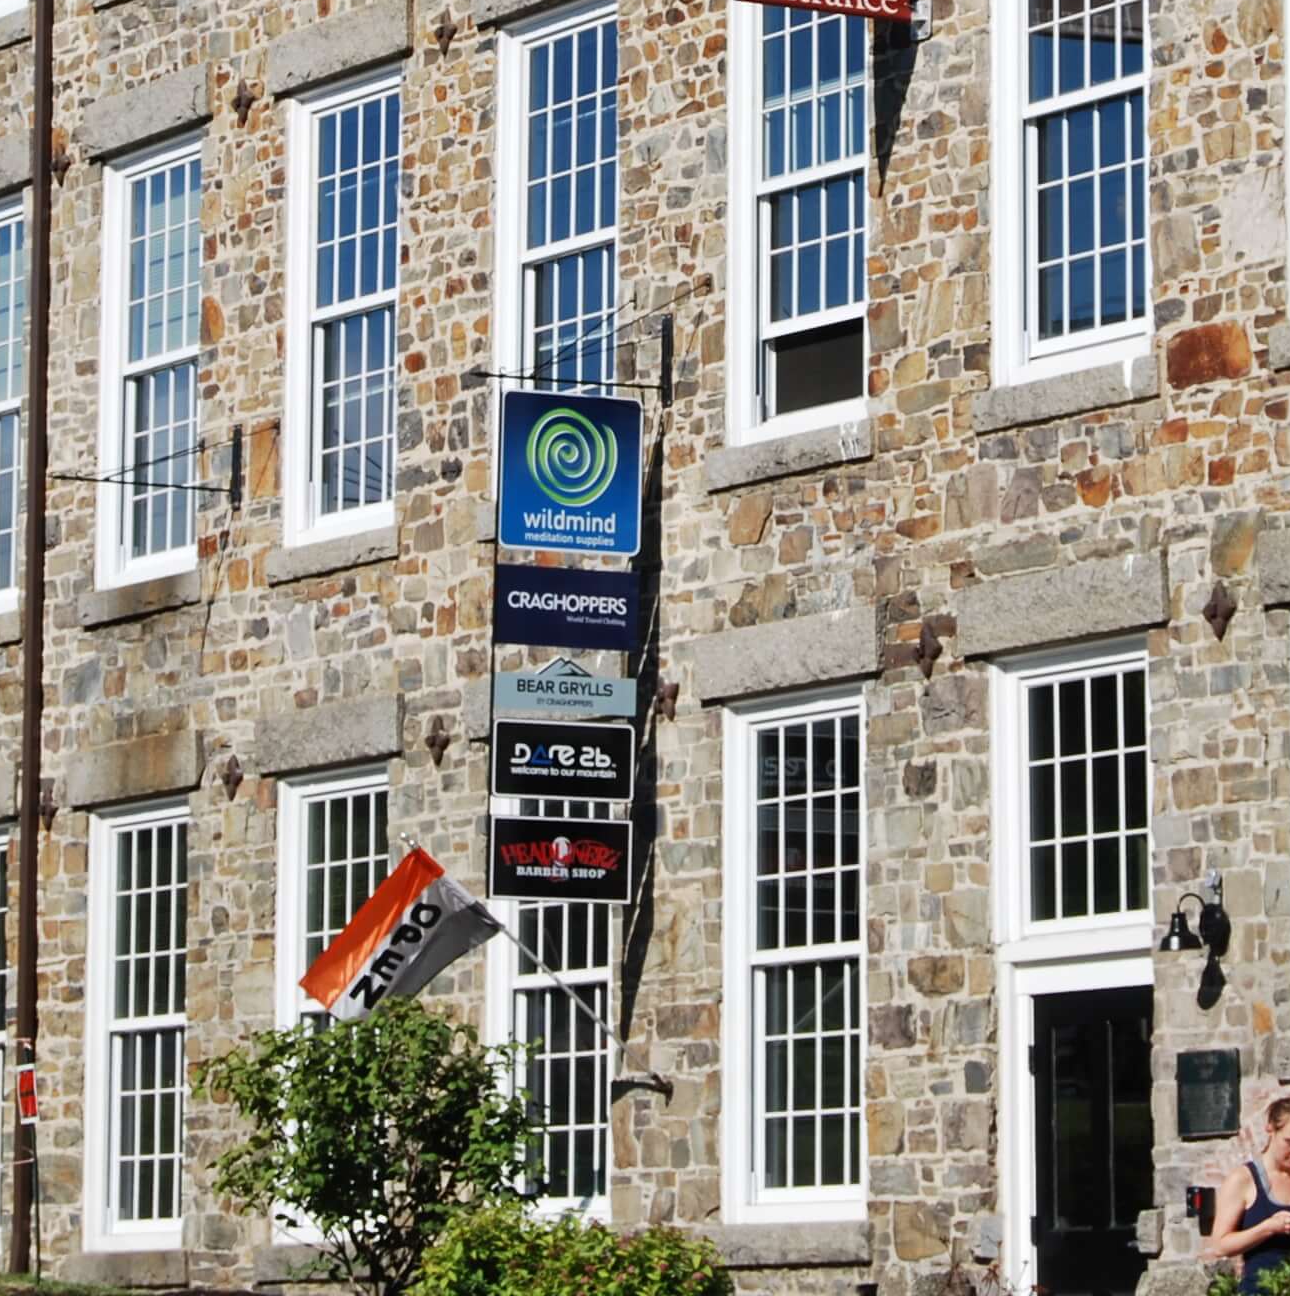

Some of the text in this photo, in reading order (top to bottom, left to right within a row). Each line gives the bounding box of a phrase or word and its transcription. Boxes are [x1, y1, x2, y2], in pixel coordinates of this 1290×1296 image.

[523, 508, 616, 534] wildmind
[524, 532, 615, 547] meditation supplies
[507, 590, 627, 615] CRAGHOPPERS
[517, 679, 613, 697] BEAR GRYLLS
[510, 766, 617, 779] welcome to our mountain
[516, 865, 606, 879] BARBER SHOP
[349, 902, 442, 1010] OPEN
